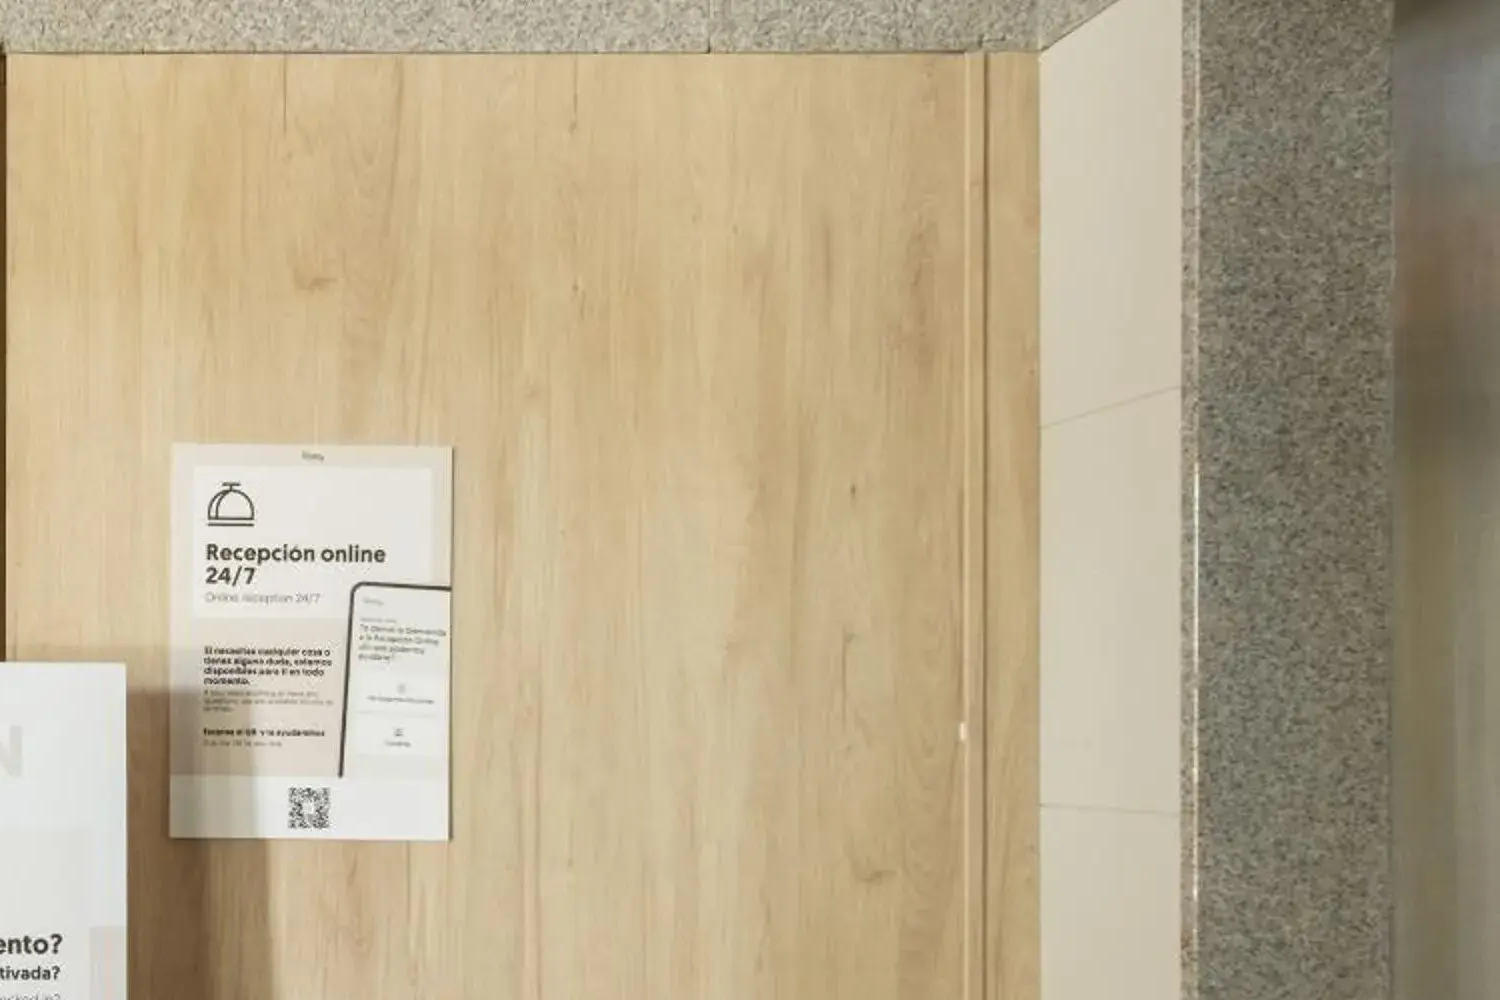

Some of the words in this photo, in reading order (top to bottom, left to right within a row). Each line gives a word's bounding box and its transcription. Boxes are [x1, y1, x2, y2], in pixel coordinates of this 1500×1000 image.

[206, 543, 315, 564] Recepción
[321, 544, 386, 562] online
[205, 566, 255, 586] 24/7
[296, 593, 321, 604] 24/7
